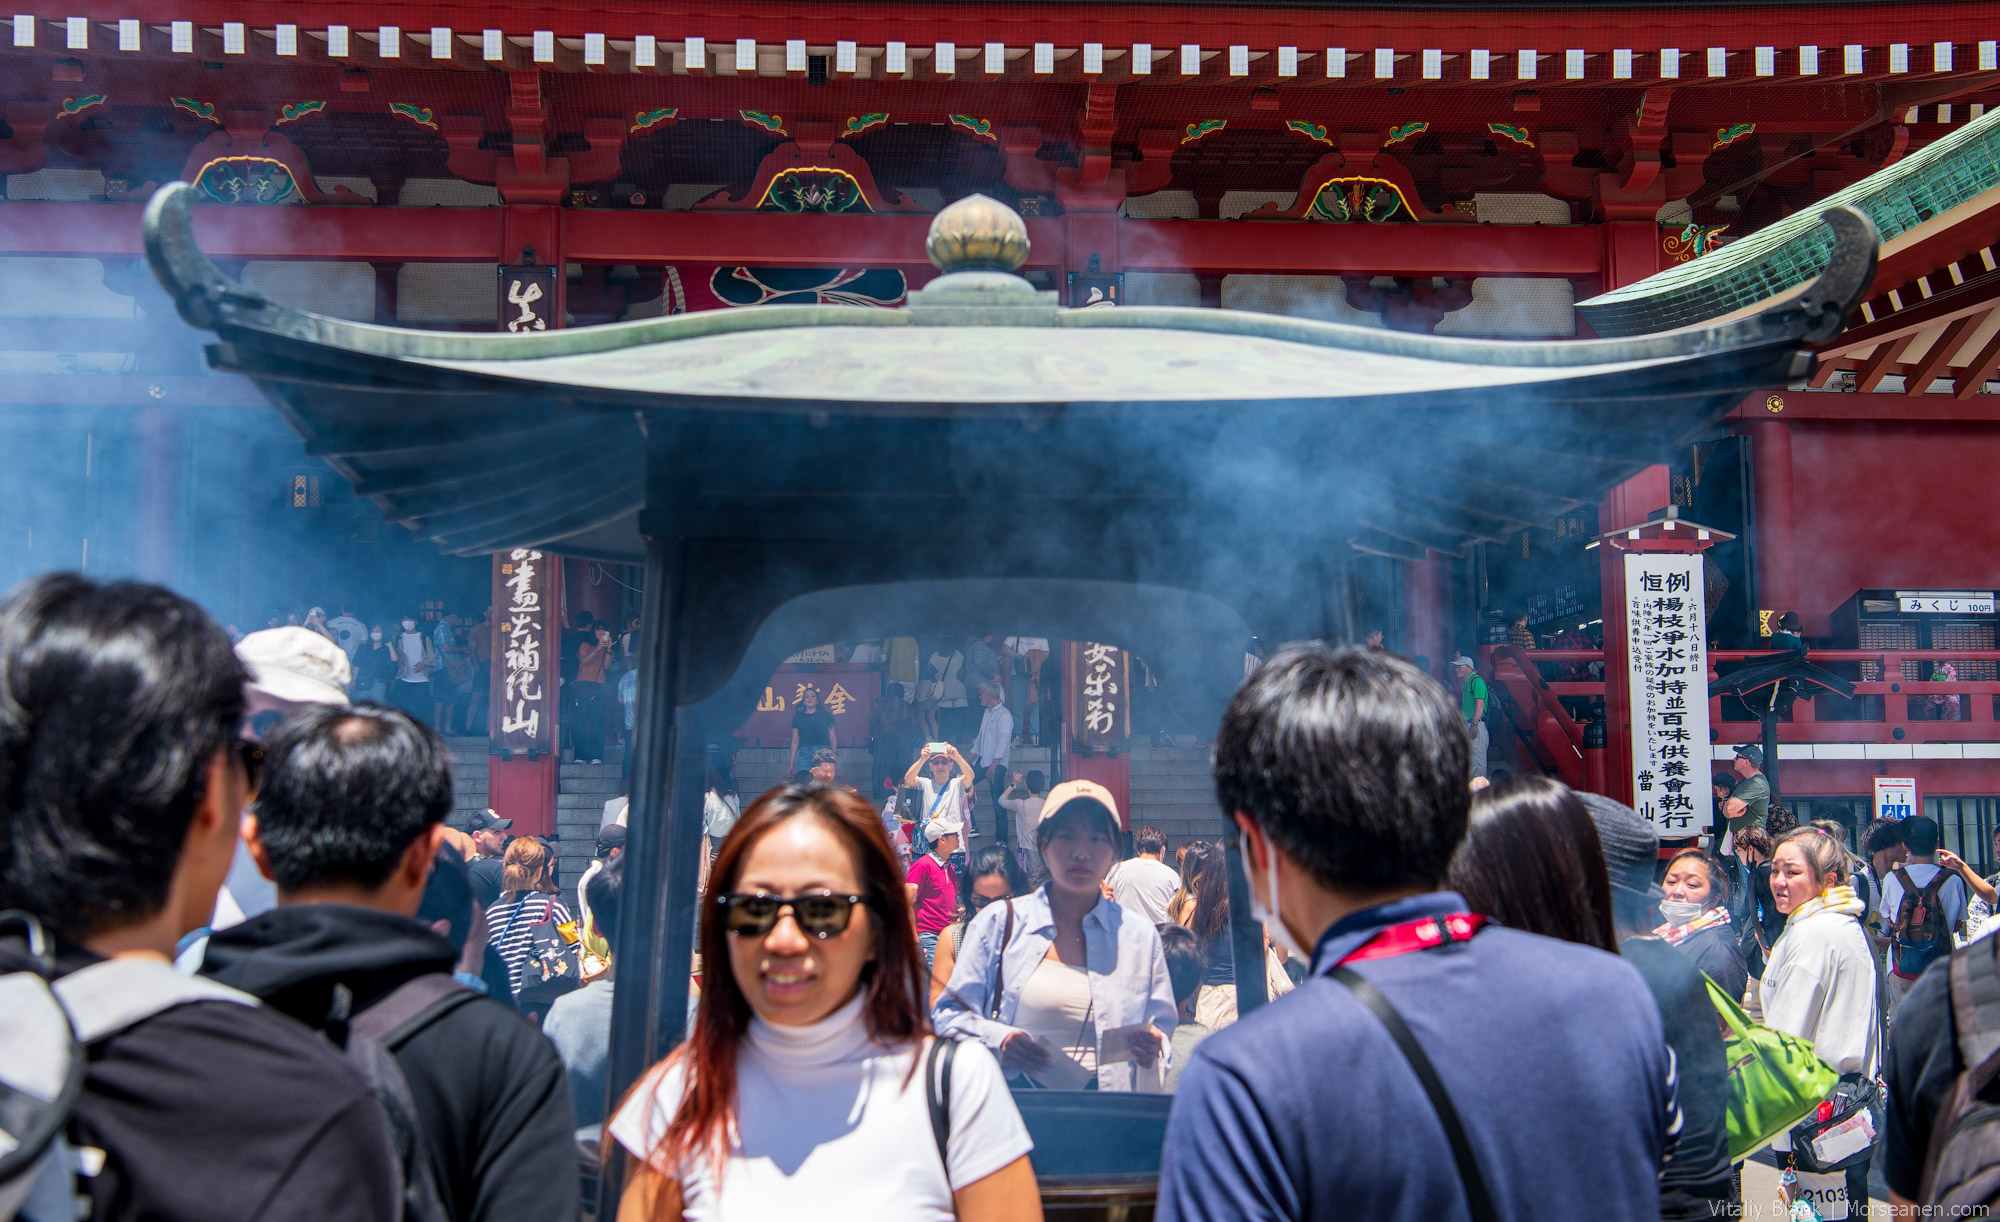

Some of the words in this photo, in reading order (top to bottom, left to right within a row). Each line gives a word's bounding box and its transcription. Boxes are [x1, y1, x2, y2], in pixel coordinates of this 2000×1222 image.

[1640, 570, 1691, 593] 恒例
[1910, 599, 1959, 611] みくじ
